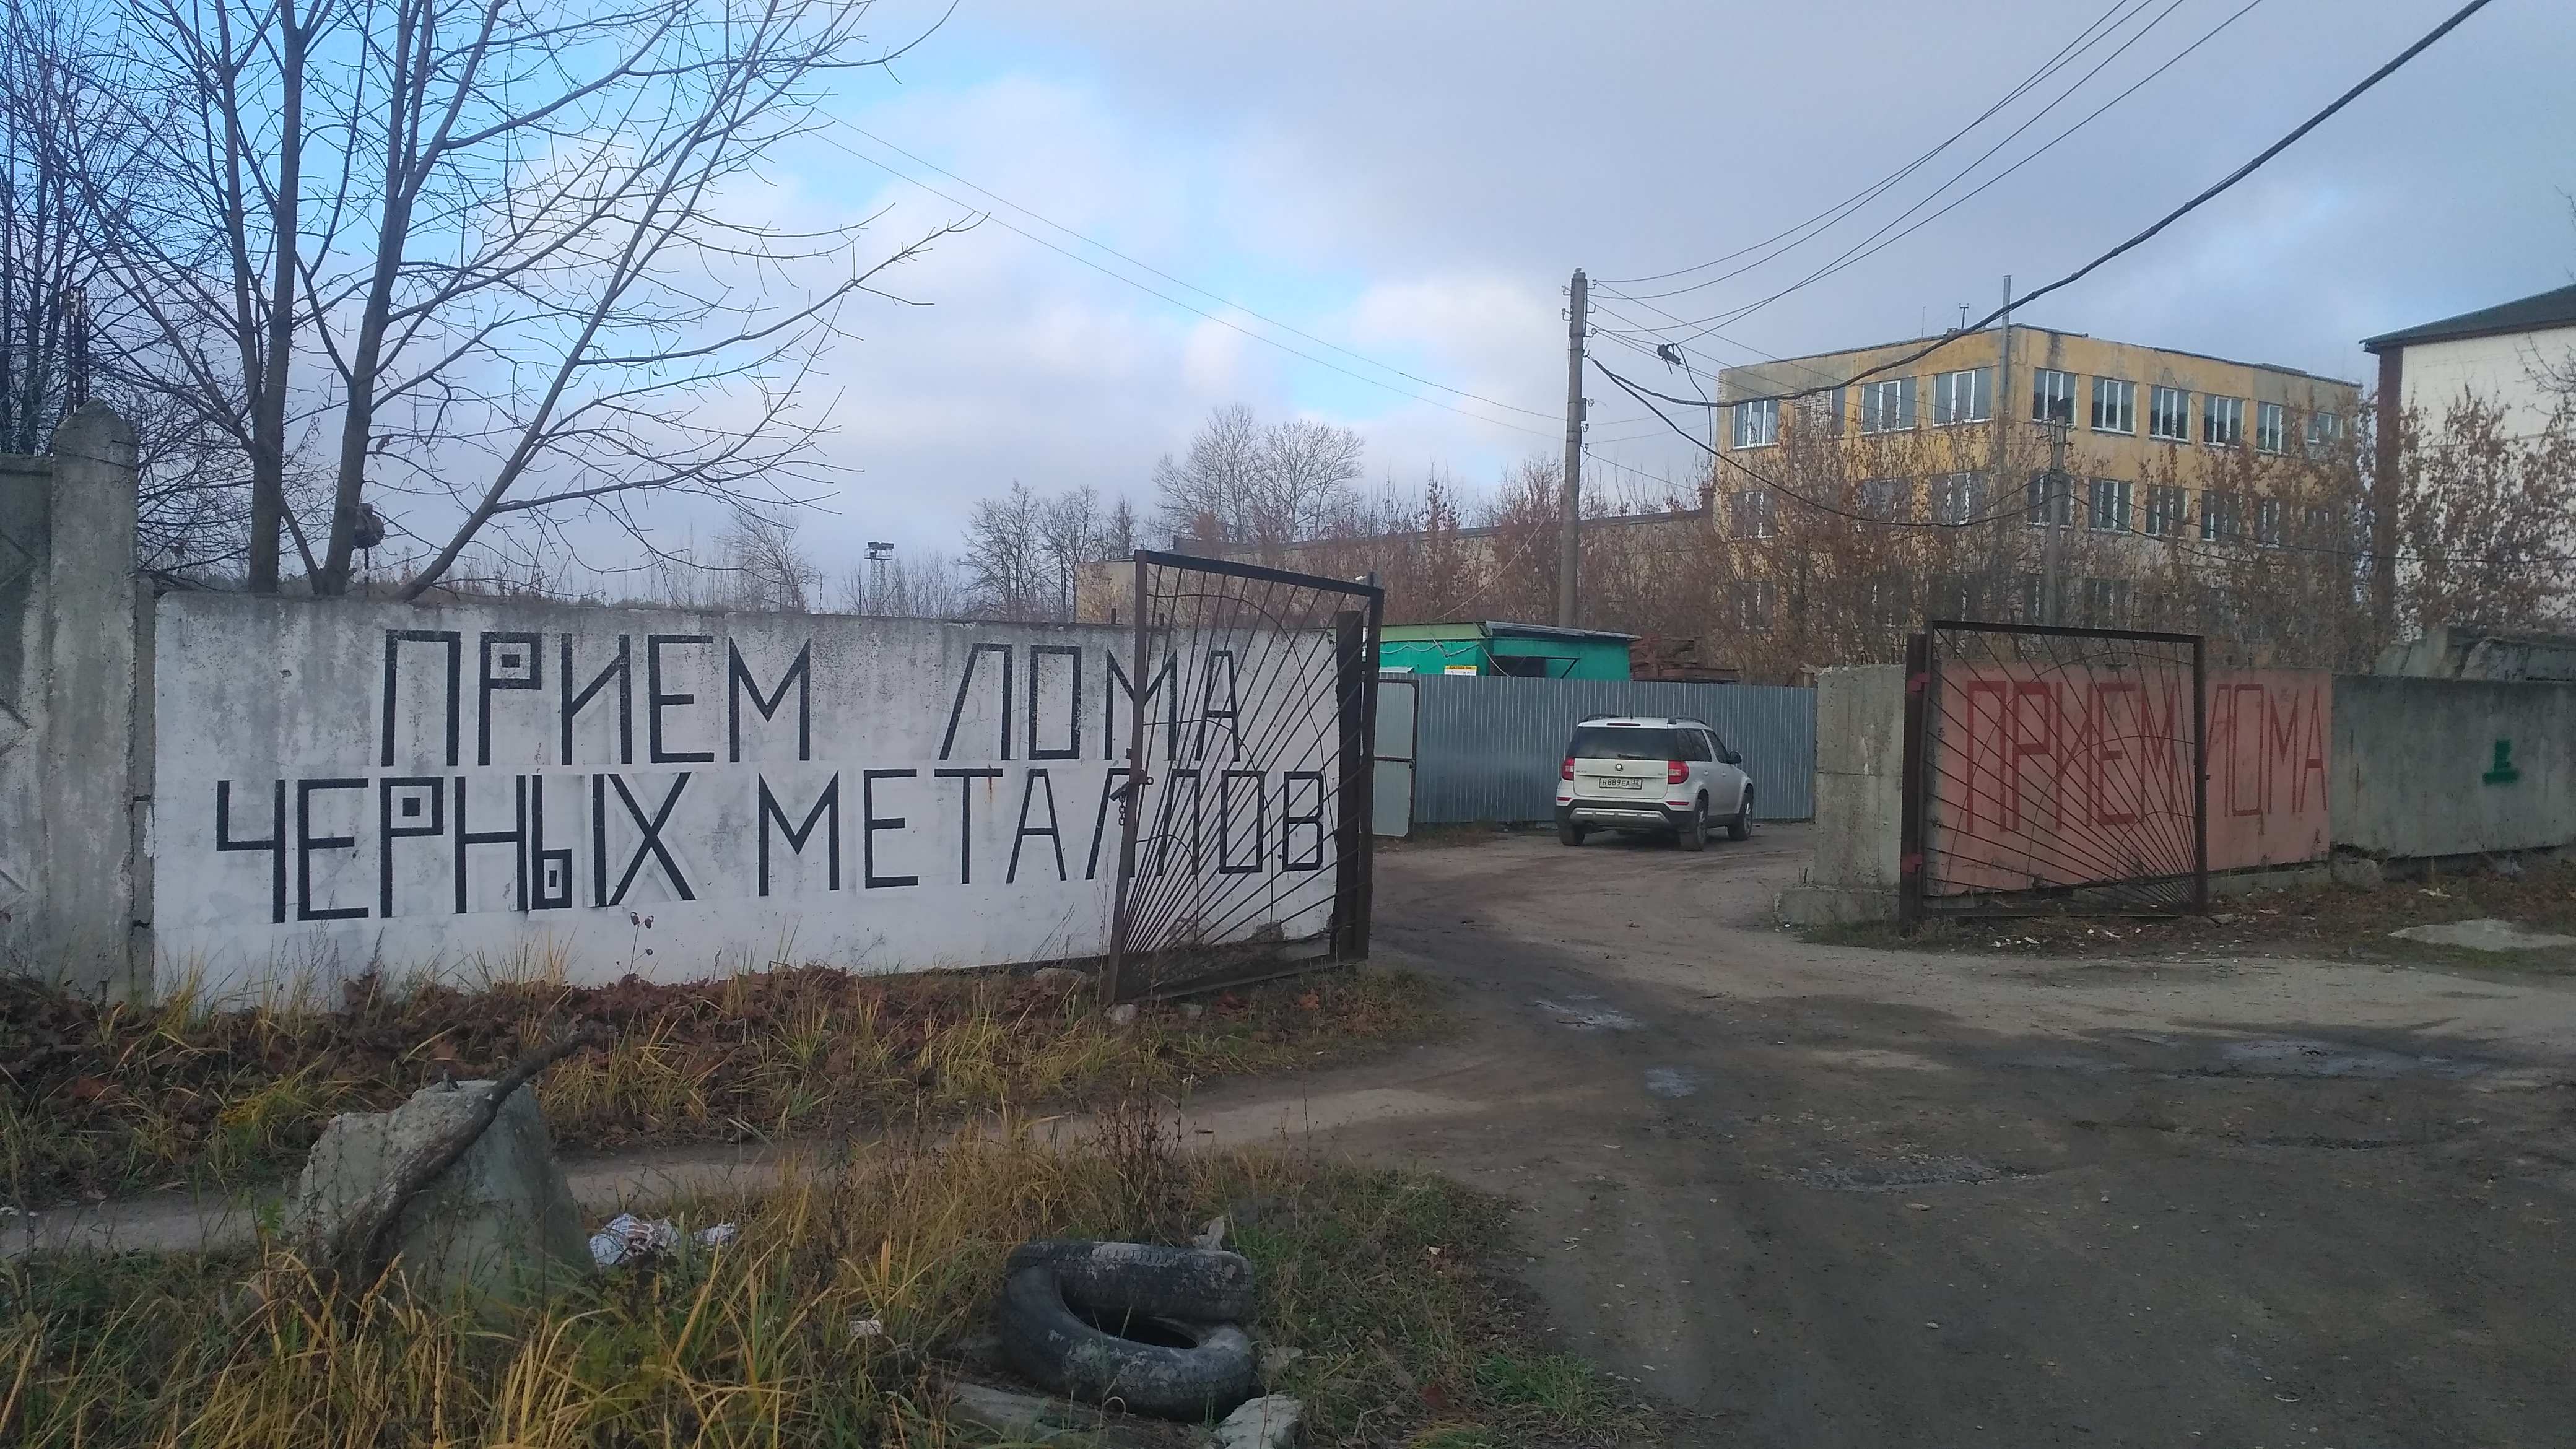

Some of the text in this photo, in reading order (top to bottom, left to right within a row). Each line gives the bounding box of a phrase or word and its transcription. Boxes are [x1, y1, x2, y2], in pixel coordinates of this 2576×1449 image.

[381, 629, 1240, 767] ПРИЕМ ЛОМА
[1967, 680, 2327, 833] ПРИЕМ ЛОМА
[216, 767, 1324, 923] ЧЕРНЫХ МЕТАЛЛОВ
